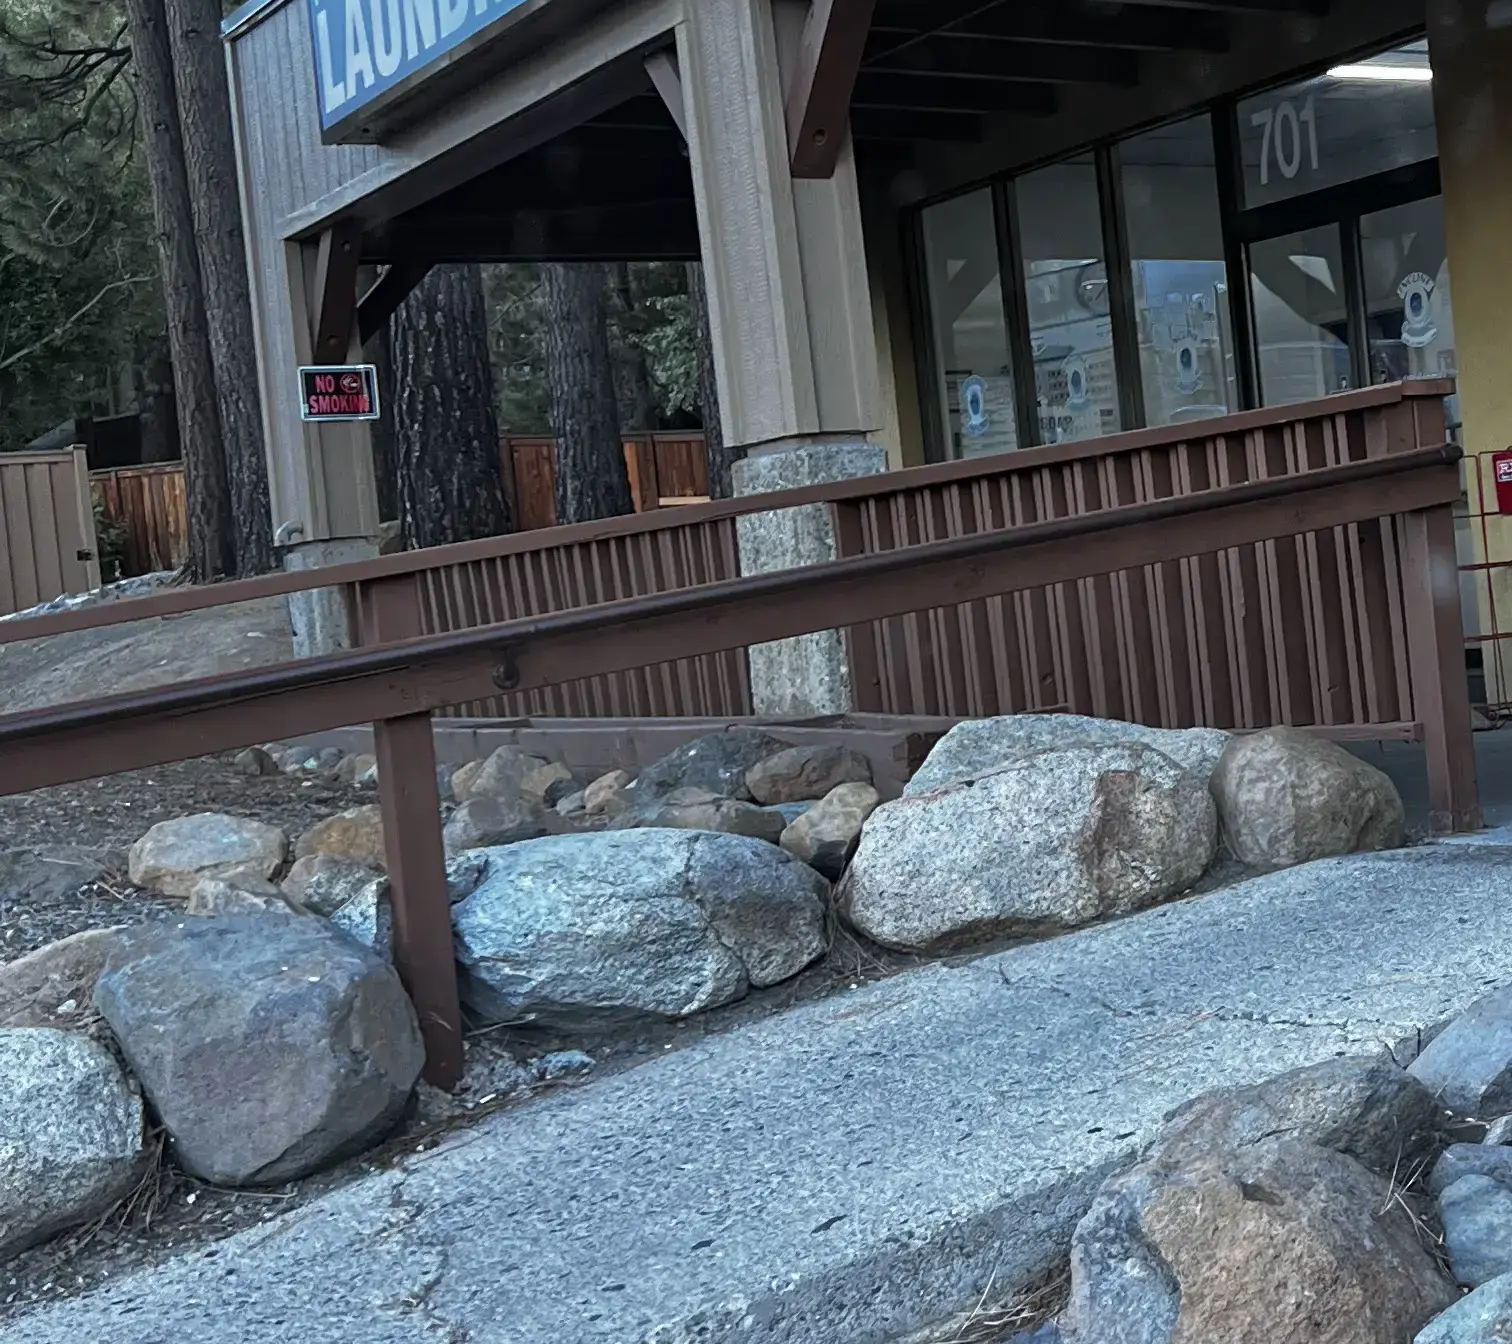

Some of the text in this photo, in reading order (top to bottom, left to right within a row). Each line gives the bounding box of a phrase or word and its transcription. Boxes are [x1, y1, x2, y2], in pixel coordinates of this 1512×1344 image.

[1251, 95, 1319, 185] 701
[315, 375, 335, 393] NO
[309, 394, 370, 414] SMOKING
